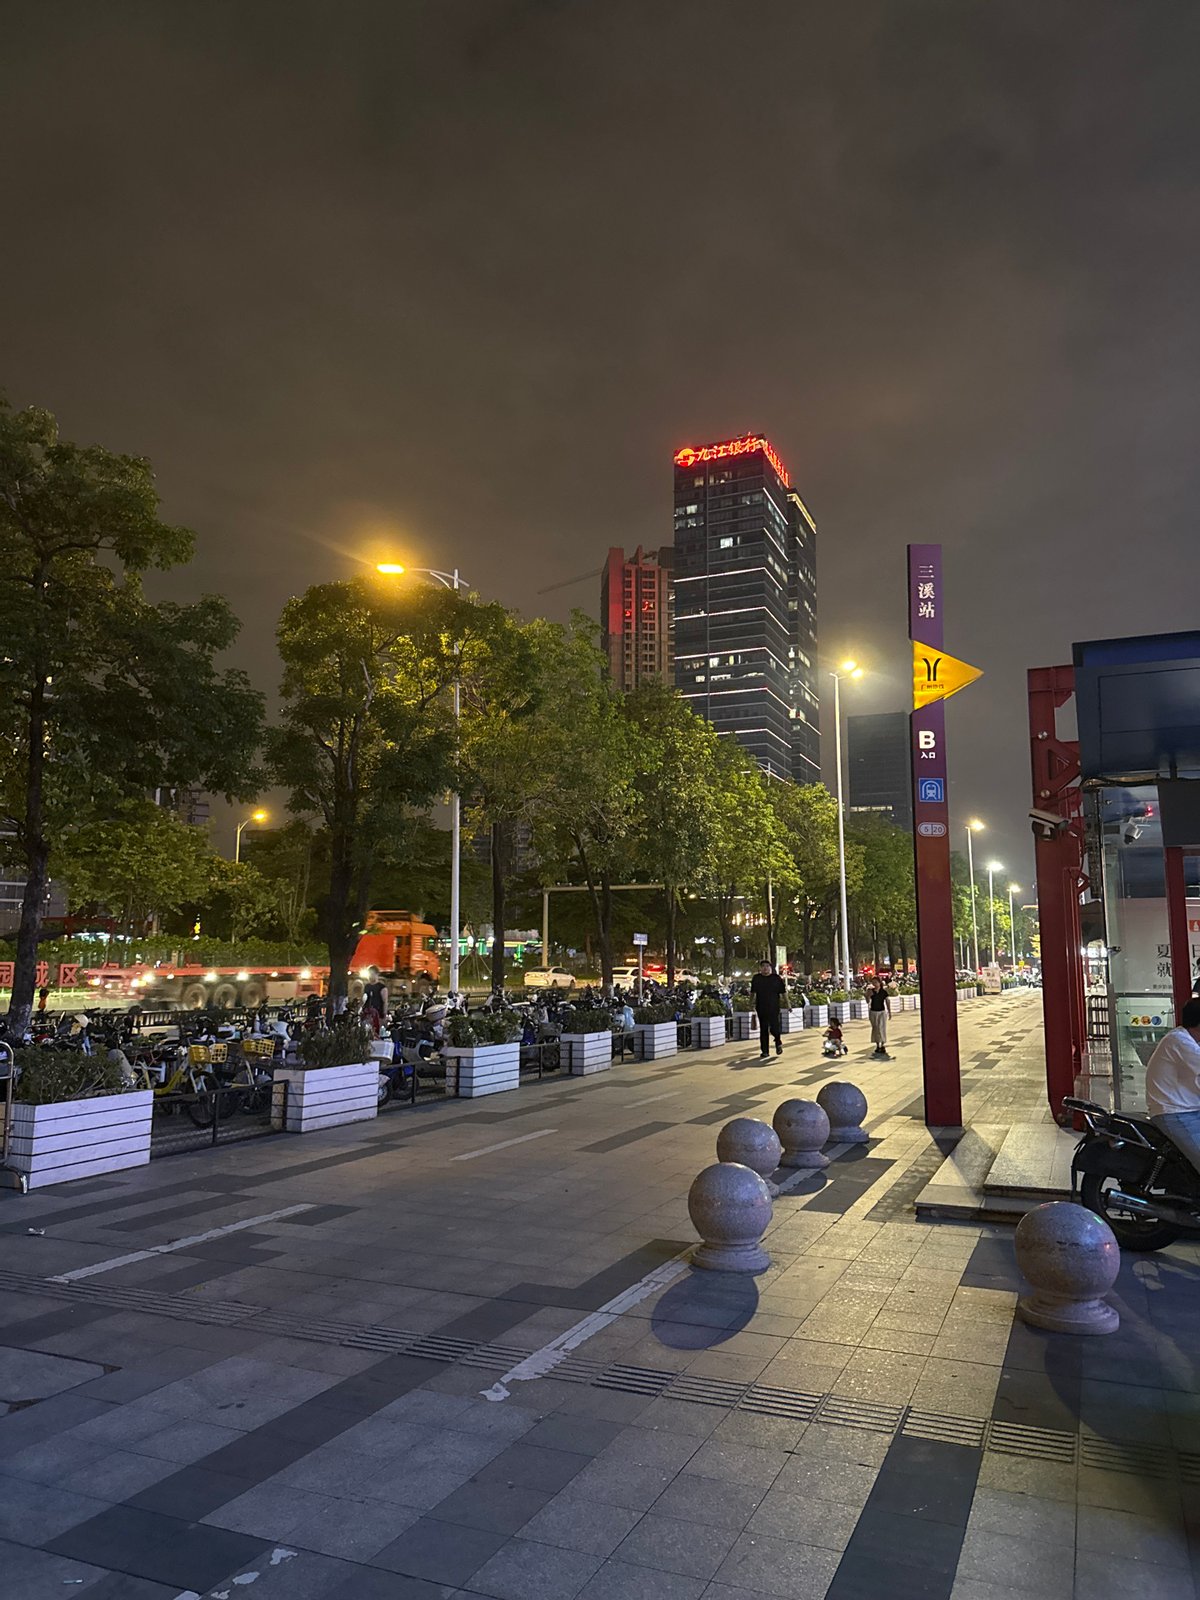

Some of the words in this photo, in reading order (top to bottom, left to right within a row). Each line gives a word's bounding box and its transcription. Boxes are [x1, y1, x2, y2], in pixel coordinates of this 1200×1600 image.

[697, 437, 762, 462] 九江银行
[918, 565, 936, 618] 三溪站
[918, 730, 936, 749] B
[920, 751, 936, 759] 入口
